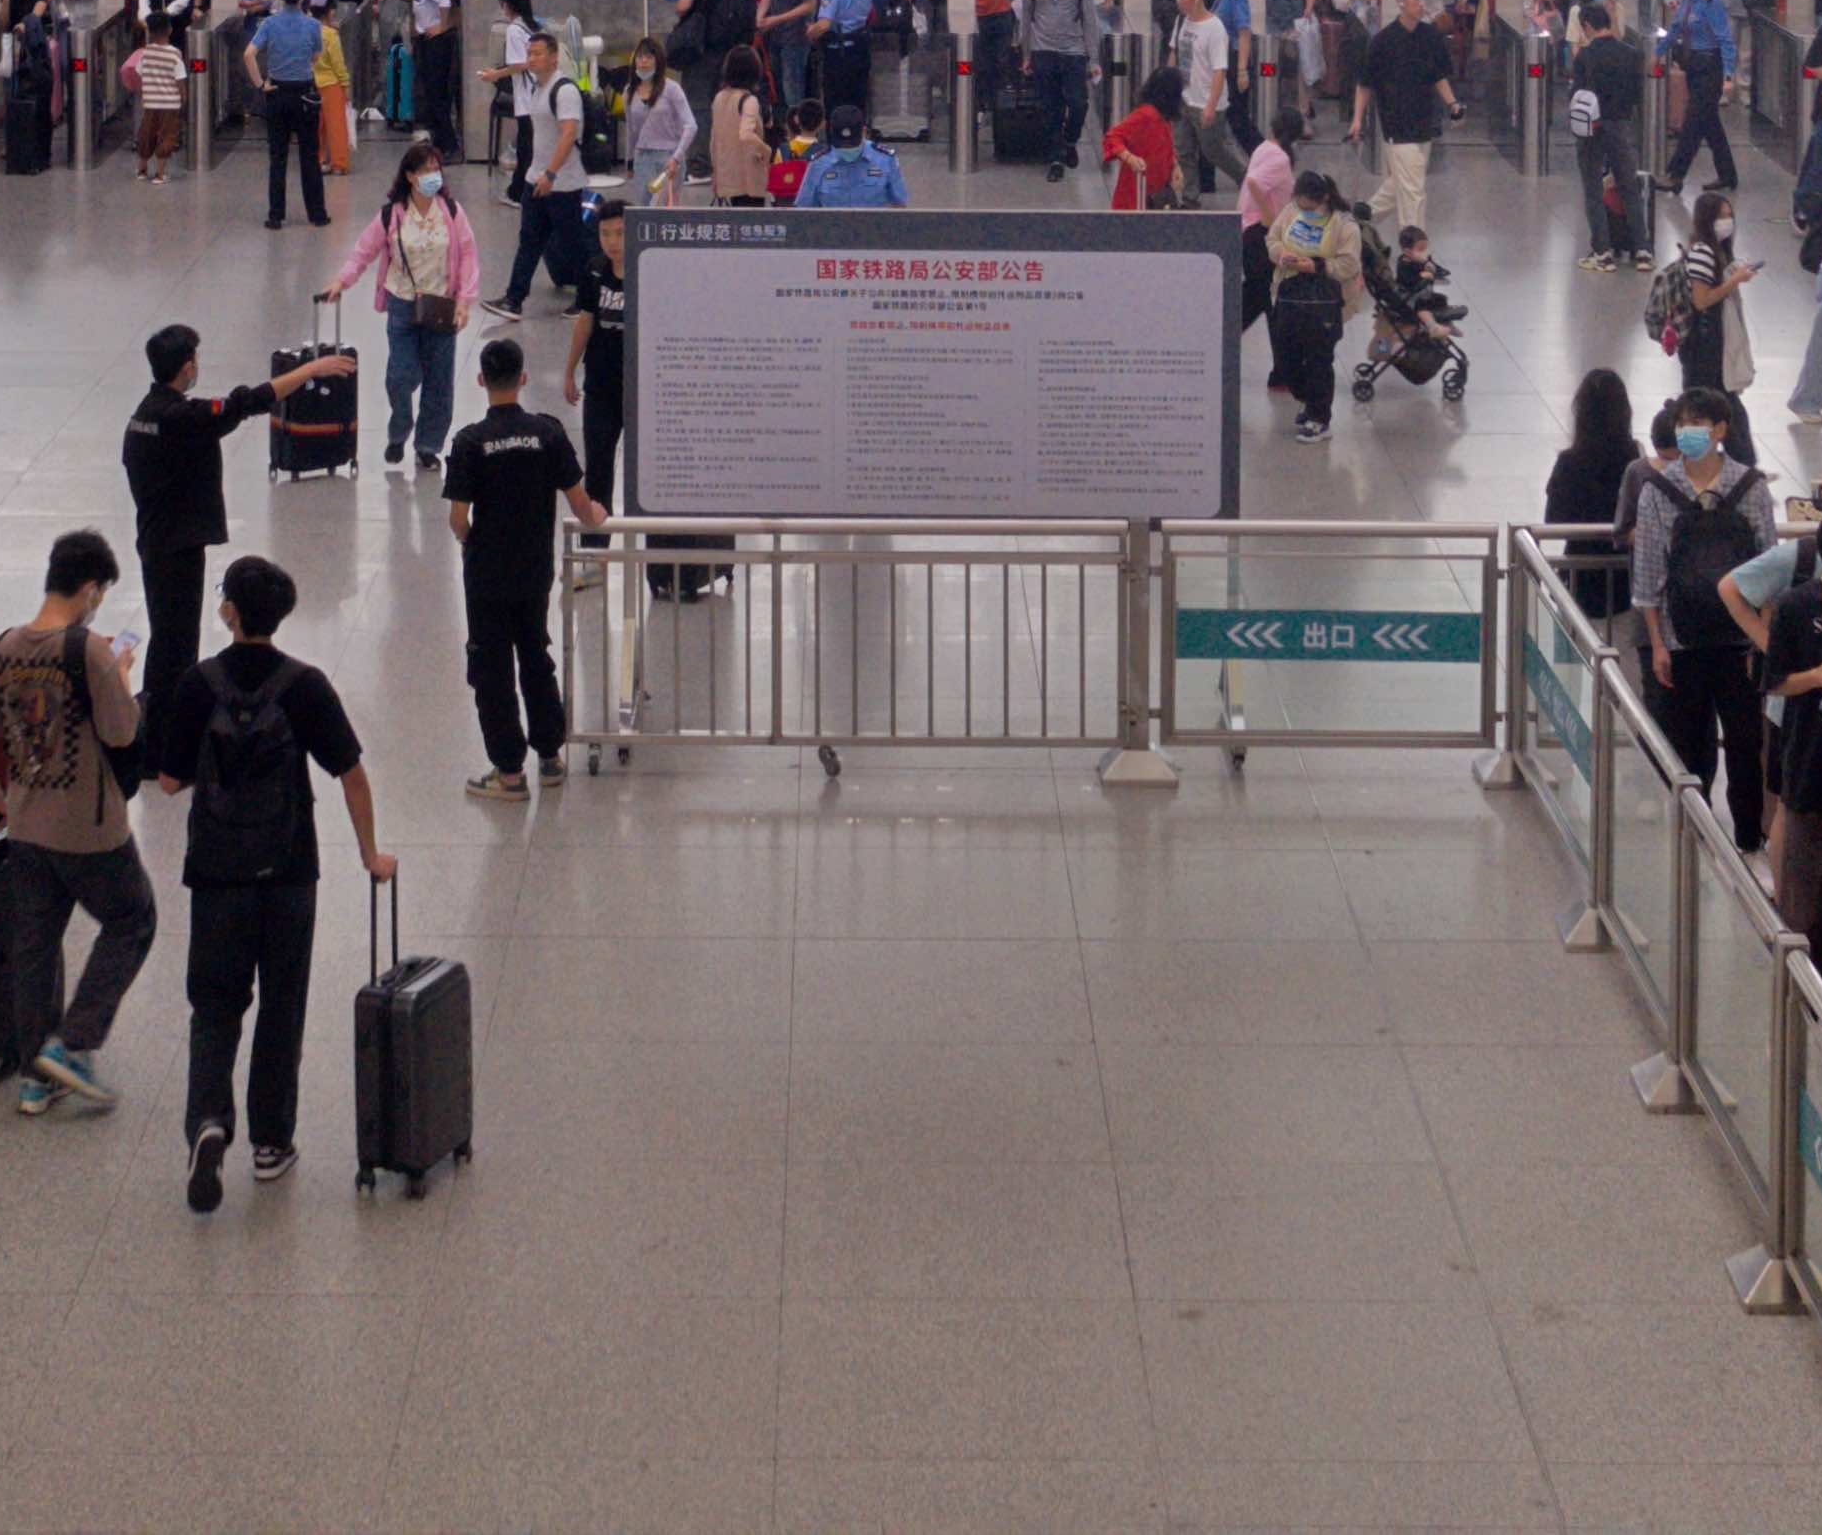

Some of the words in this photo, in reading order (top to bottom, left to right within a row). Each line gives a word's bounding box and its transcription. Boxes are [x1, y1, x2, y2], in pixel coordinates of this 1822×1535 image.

[661, 223, 731, 242] 行业规范
[1302, 618, 1355, 649] 出口
